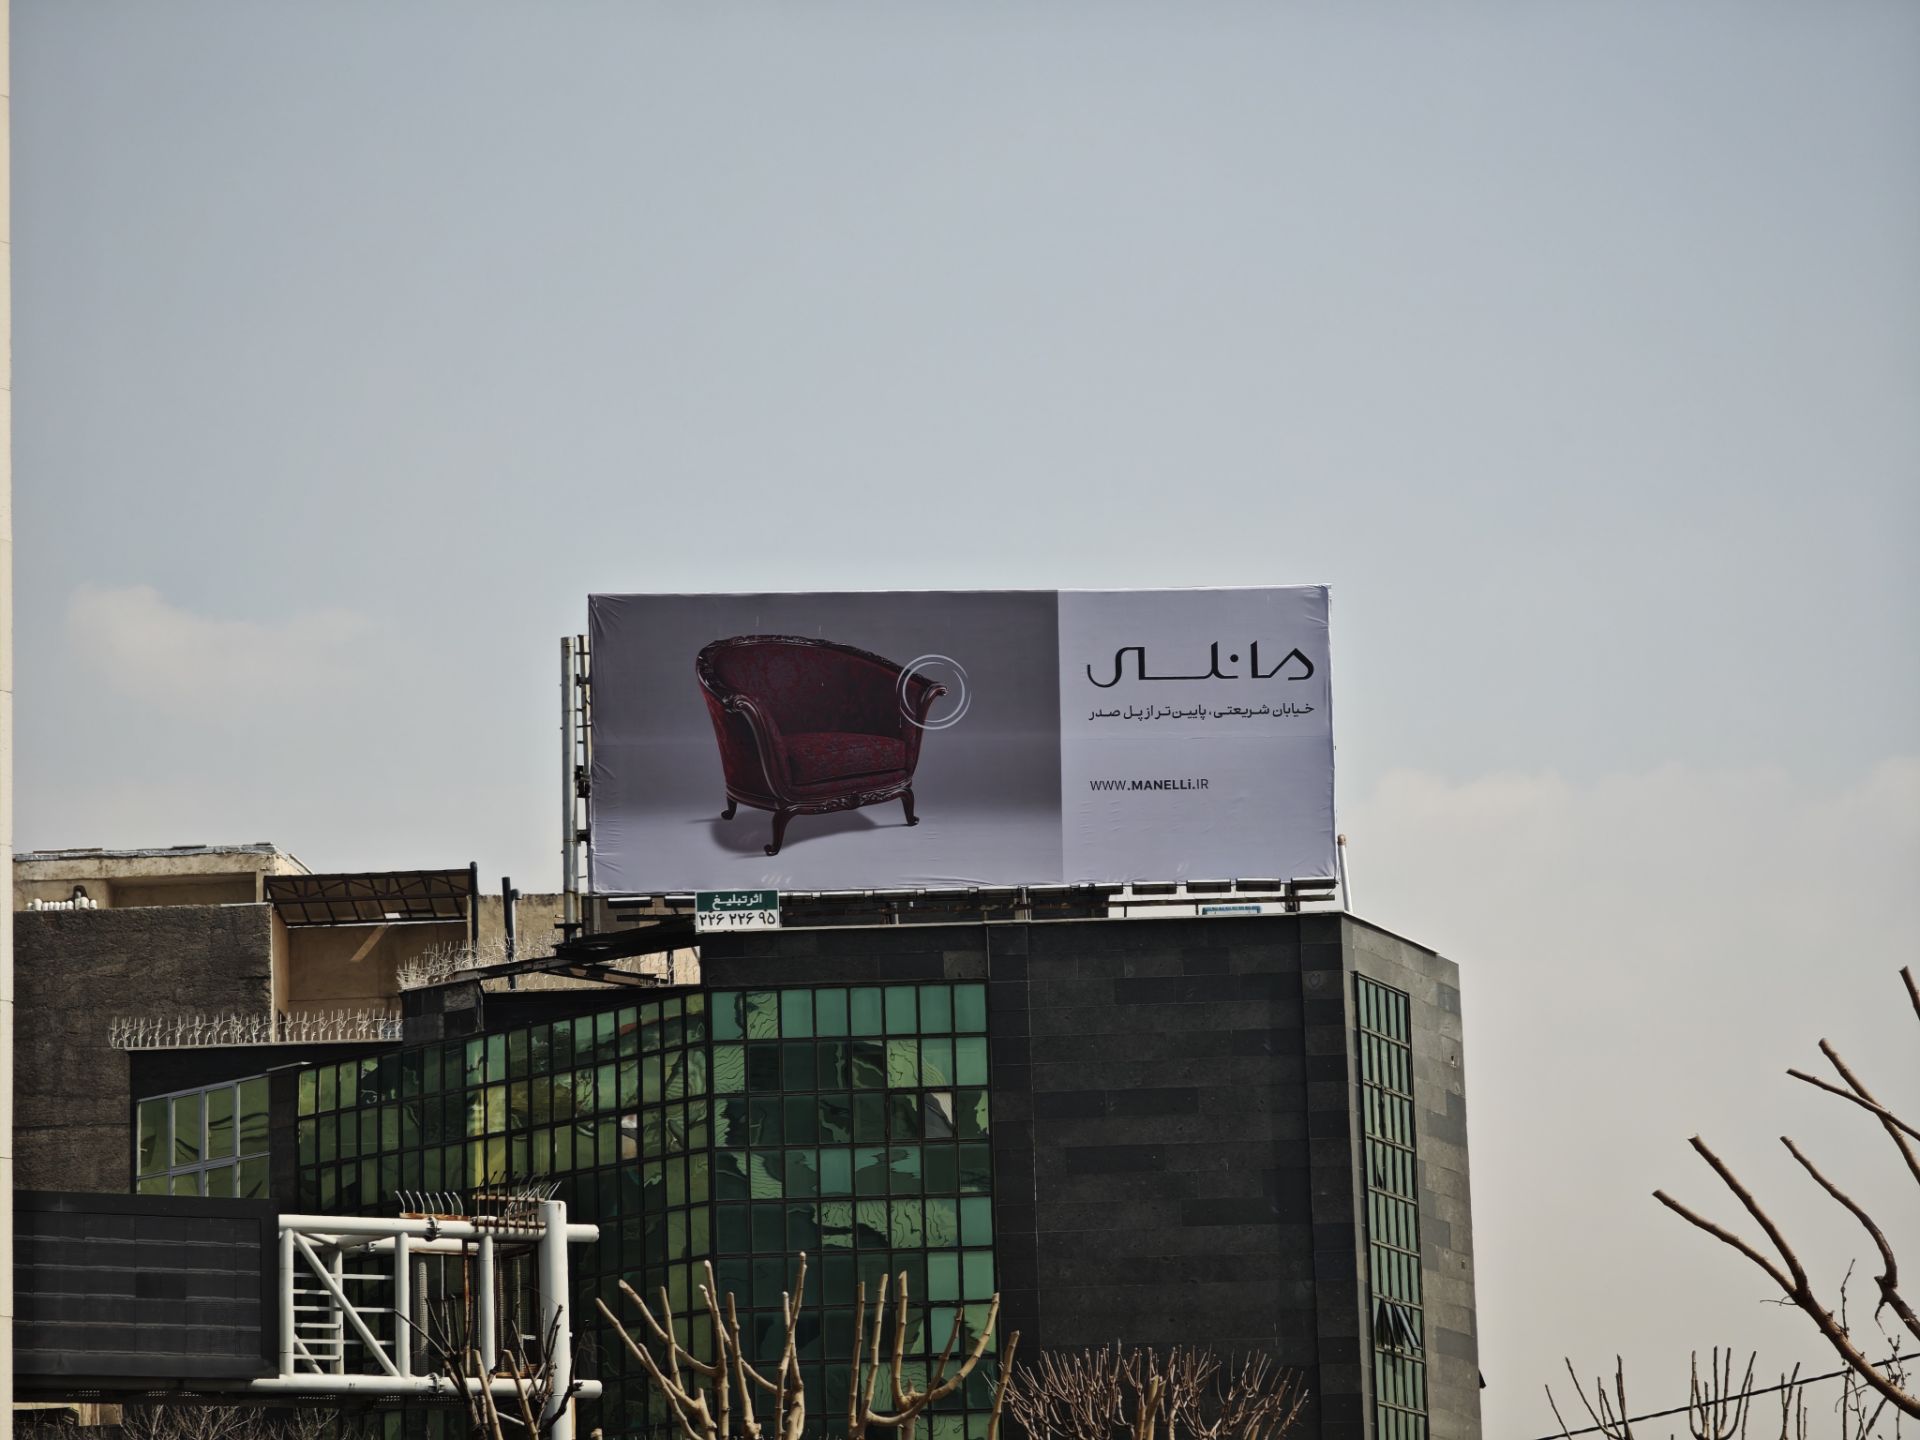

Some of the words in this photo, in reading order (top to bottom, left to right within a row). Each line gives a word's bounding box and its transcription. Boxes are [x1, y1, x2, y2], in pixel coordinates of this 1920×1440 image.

[1086, 639, 1315, 689] مانلی
[1088, 707, 1121, 721] صدر
[1123, 704, 1144, 721] پل
[1272, 702, 1315, 719] خیابان
[711, 893, 748, 911] تبلیغ
